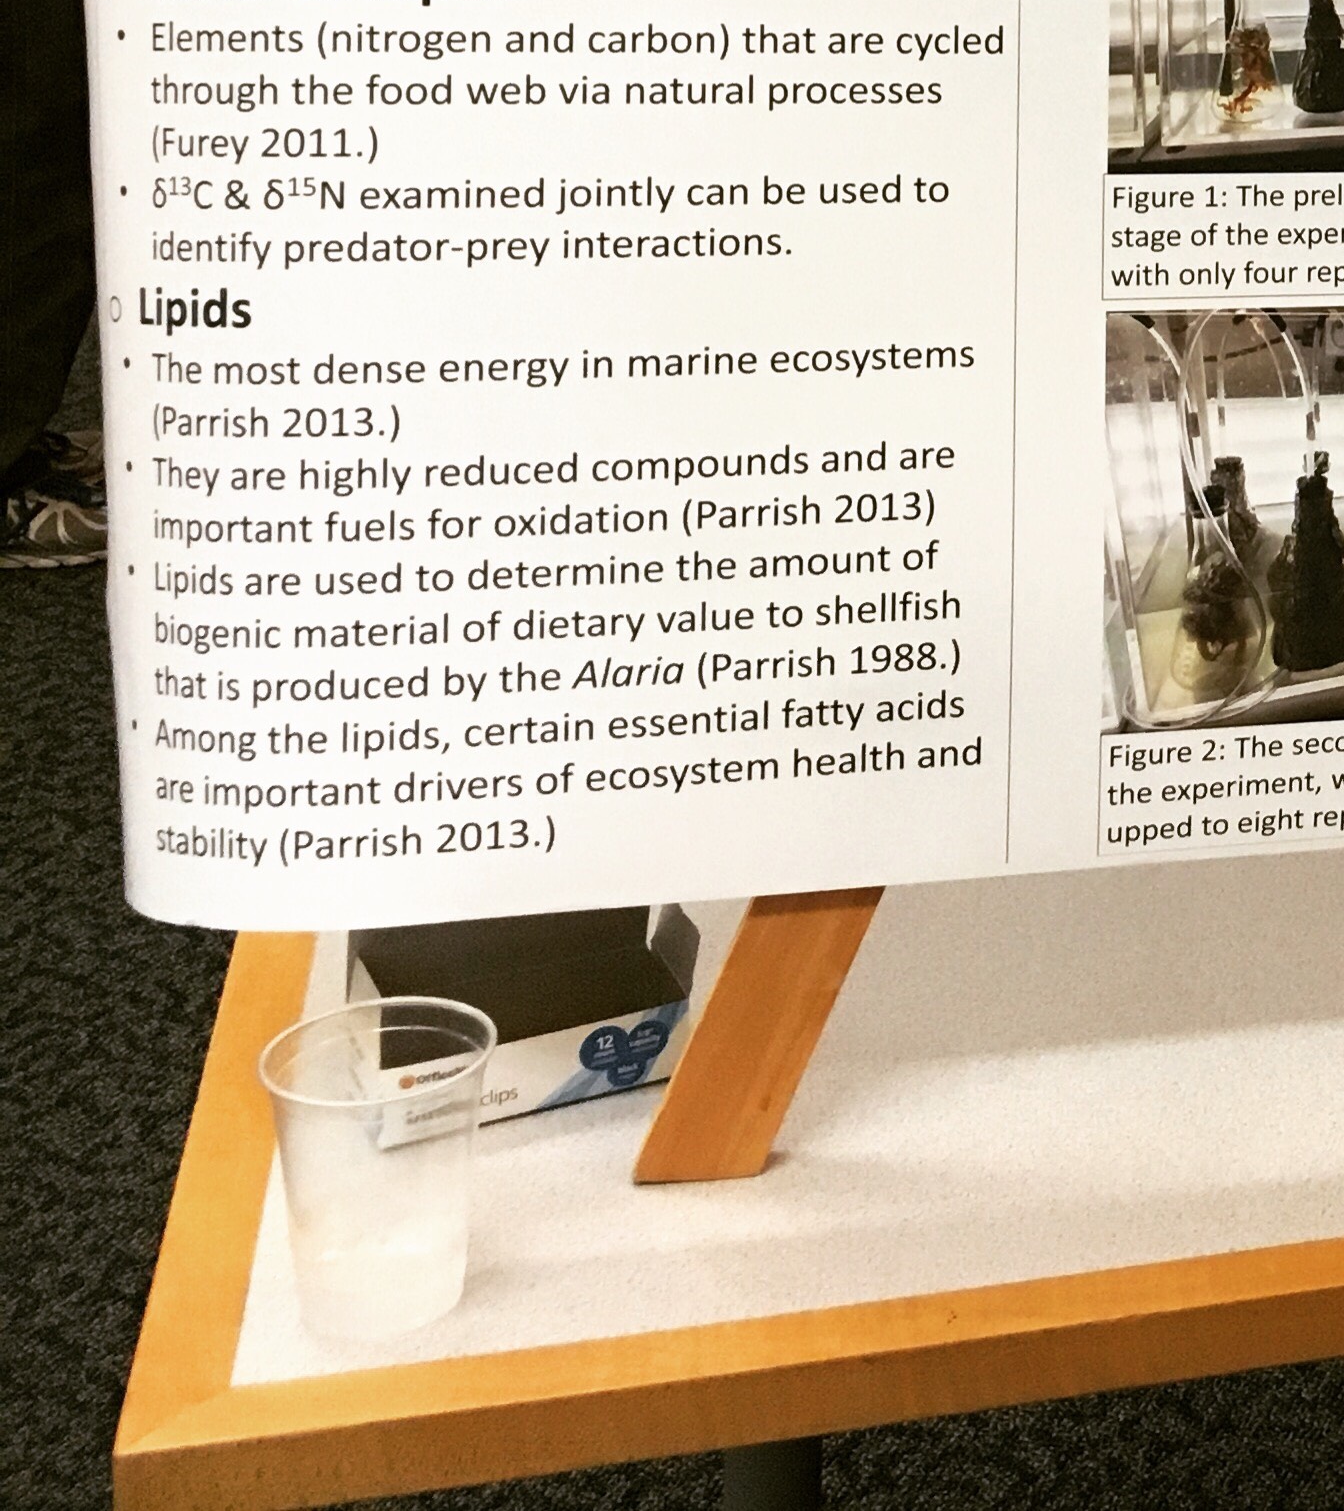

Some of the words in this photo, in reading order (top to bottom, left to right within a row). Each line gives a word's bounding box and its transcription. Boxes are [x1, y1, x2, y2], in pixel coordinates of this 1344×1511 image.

[1113, 186, 1194, 214] Figure
[1205, 186, 1226, 207] 1:
[1236, 184, 1284, 207] The
[1112, 227, 1181, 252] stage
[1191, 223, 1218, 246] of
[1225, 222, 1268, 246] the
[1111, 262, 1169, 286] with
[1179, 261, 1236, 289] only
[1244, 260, 1298, 284] four
[140, 287, 251, 336] Lipids
[1110, 744, 1192, 771] Figure
[1202, 739, 1224, 761] 2:
[1234, 735, 1283, 759] The
[596, 1035, 614, 1050] 12
